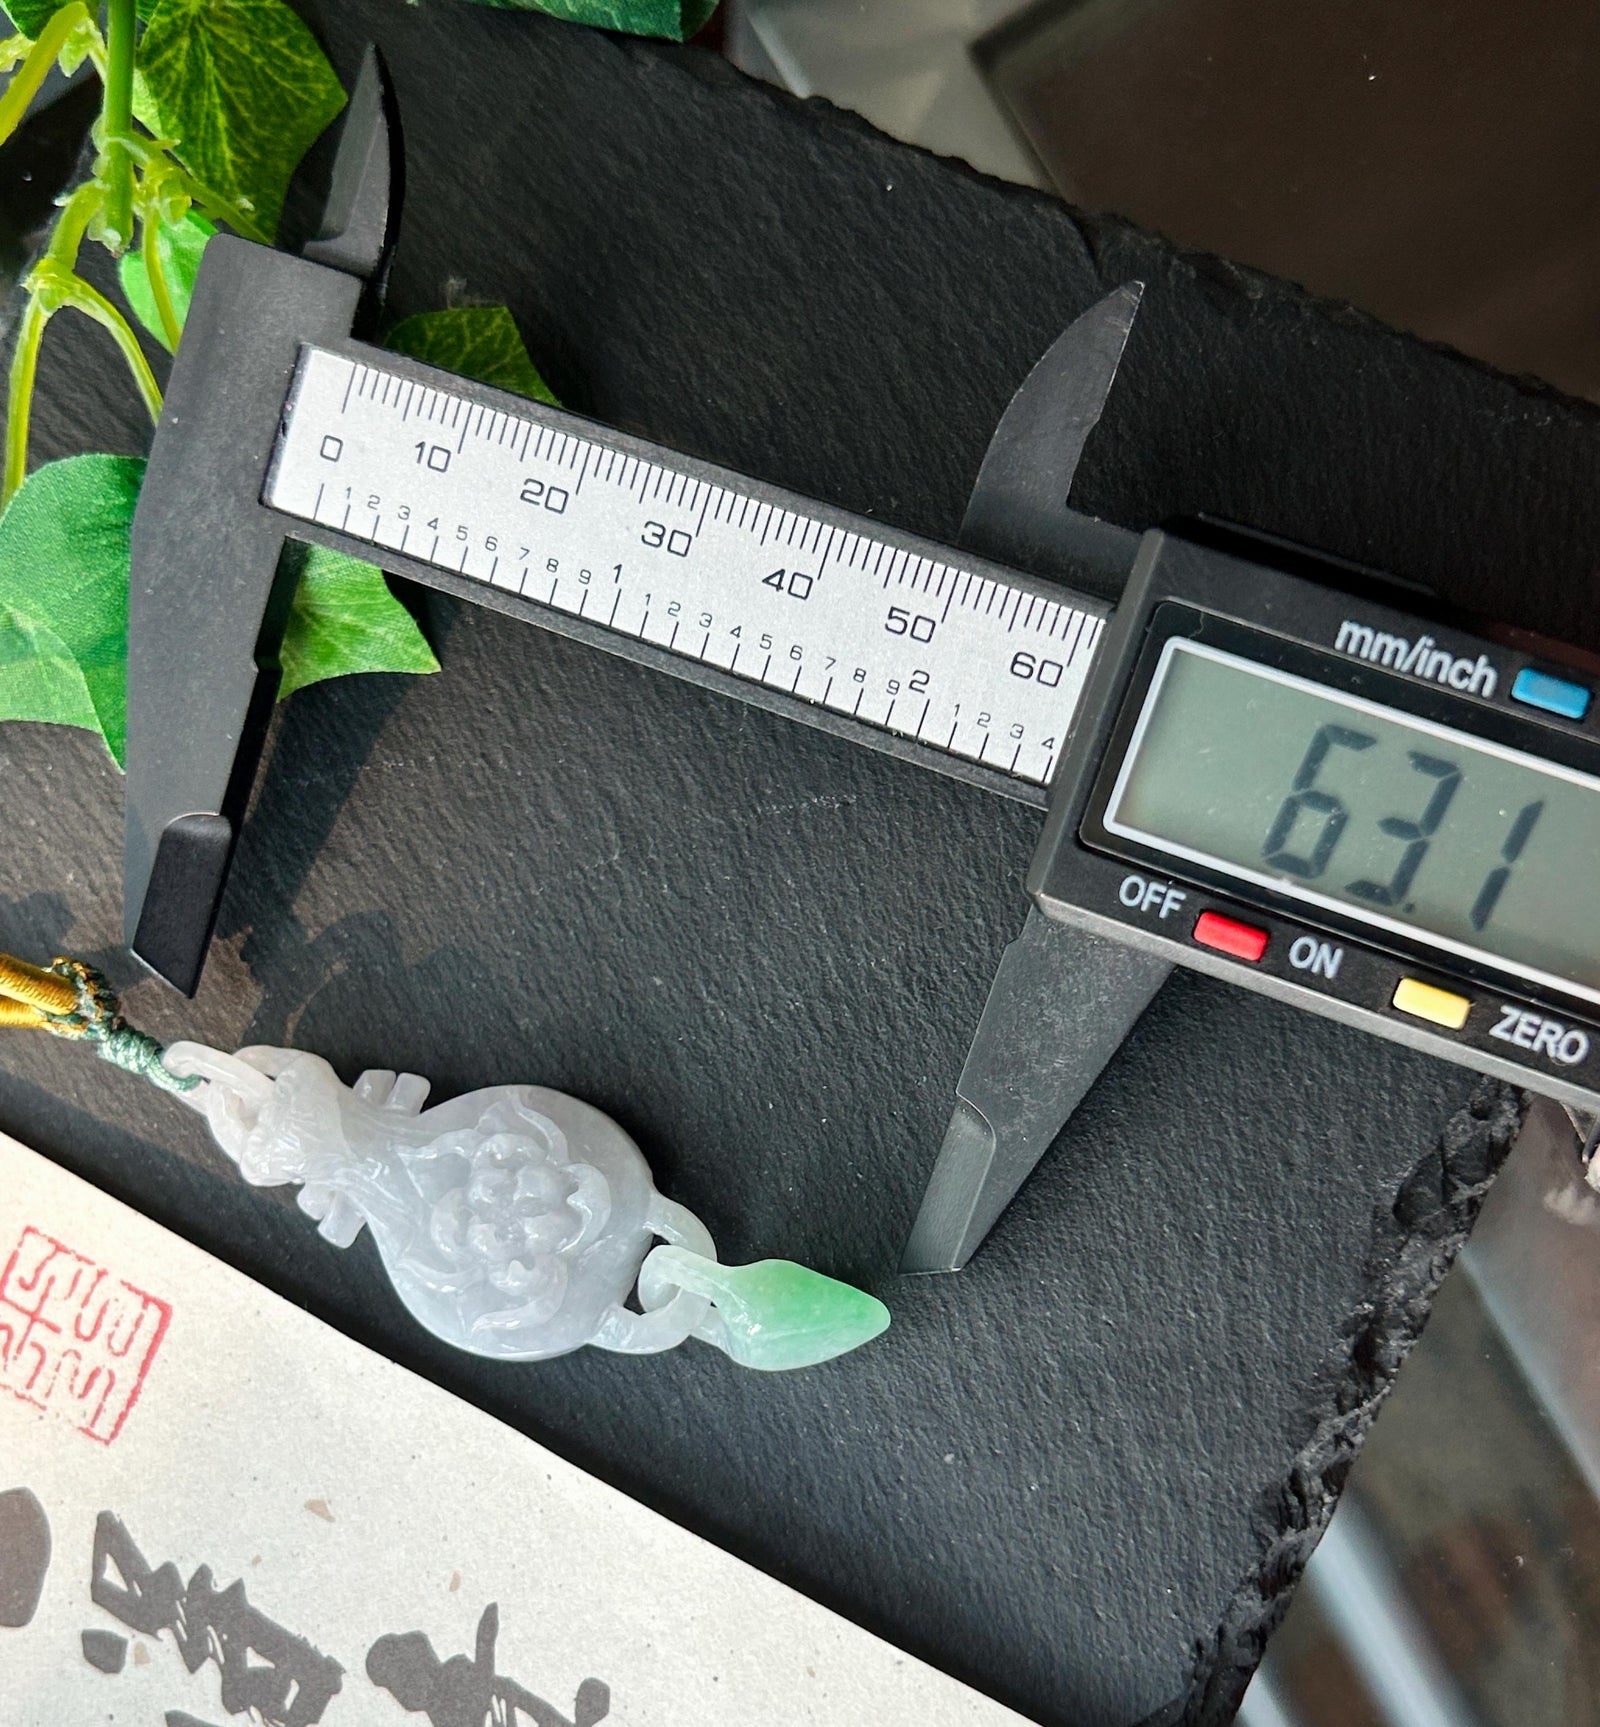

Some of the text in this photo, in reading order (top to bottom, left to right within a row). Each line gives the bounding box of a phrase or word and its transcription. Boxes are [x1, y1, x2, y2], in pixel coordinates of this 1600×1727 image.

[319, 435, 1064, 688] 0 10 20 30 40 50 60
[345, 486, 1055, 750] 1 2 3 4 5 6 7 8 9 1 1 2 3 4 5 6 7 8 9 2 1 2 3 4
[1334, 620, 1498, 698] mm/inch
[1119, 875, 1187, 919] OFF
[1289, 936, 1345, 979] ON
[1489, 1005, 1589, 1064] ZERO
